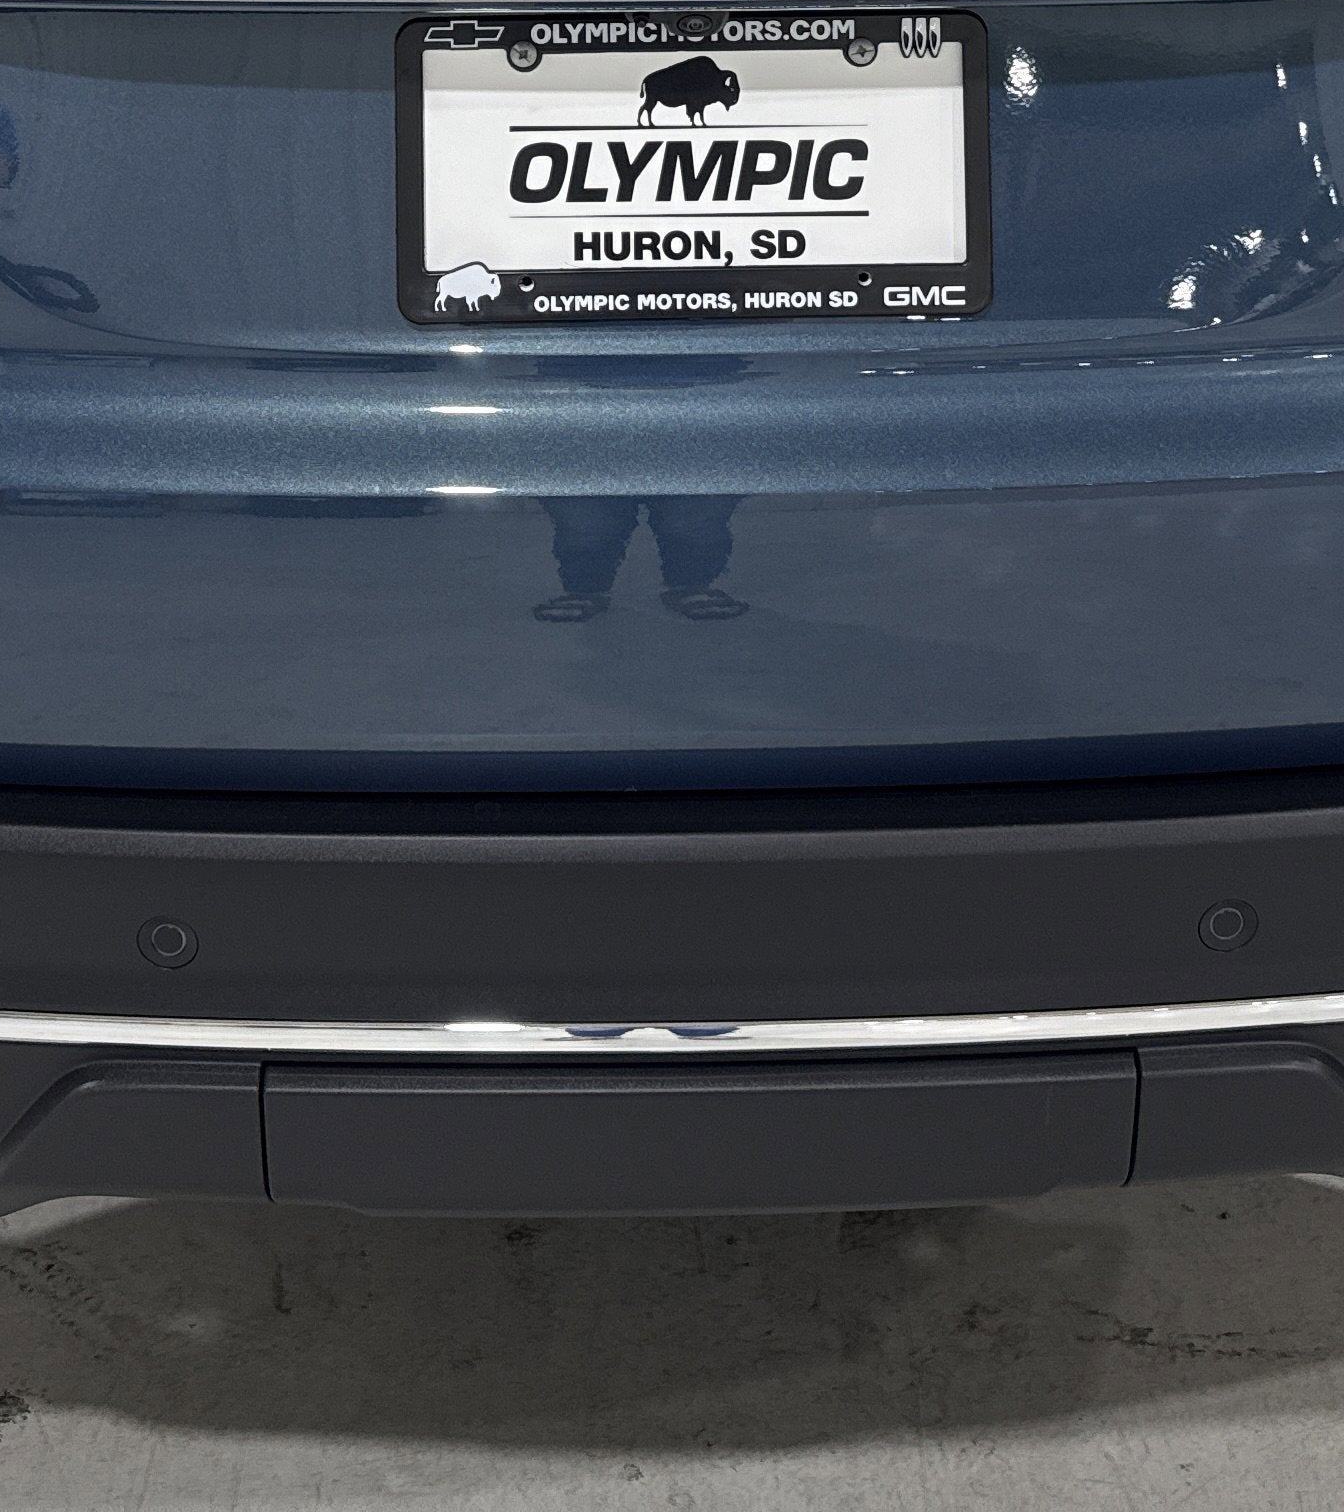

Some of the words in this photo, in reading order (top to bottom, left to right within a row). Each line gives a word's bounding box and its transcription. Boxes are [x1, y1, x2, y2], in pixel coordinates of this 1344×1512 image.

[508, 137, 870, 205] OLYMPIC
[573, 228, 735, 267] HURON,
[749, 229, 806, 260] SD
[533, 293, 630, 313] OLYMPIC
[636, 292, 738, 314] MOTORS,
[743, 291, 823, 311] HURON
[828, 290, 859, 309] SD
[883, 285, 966, 308] GMC
